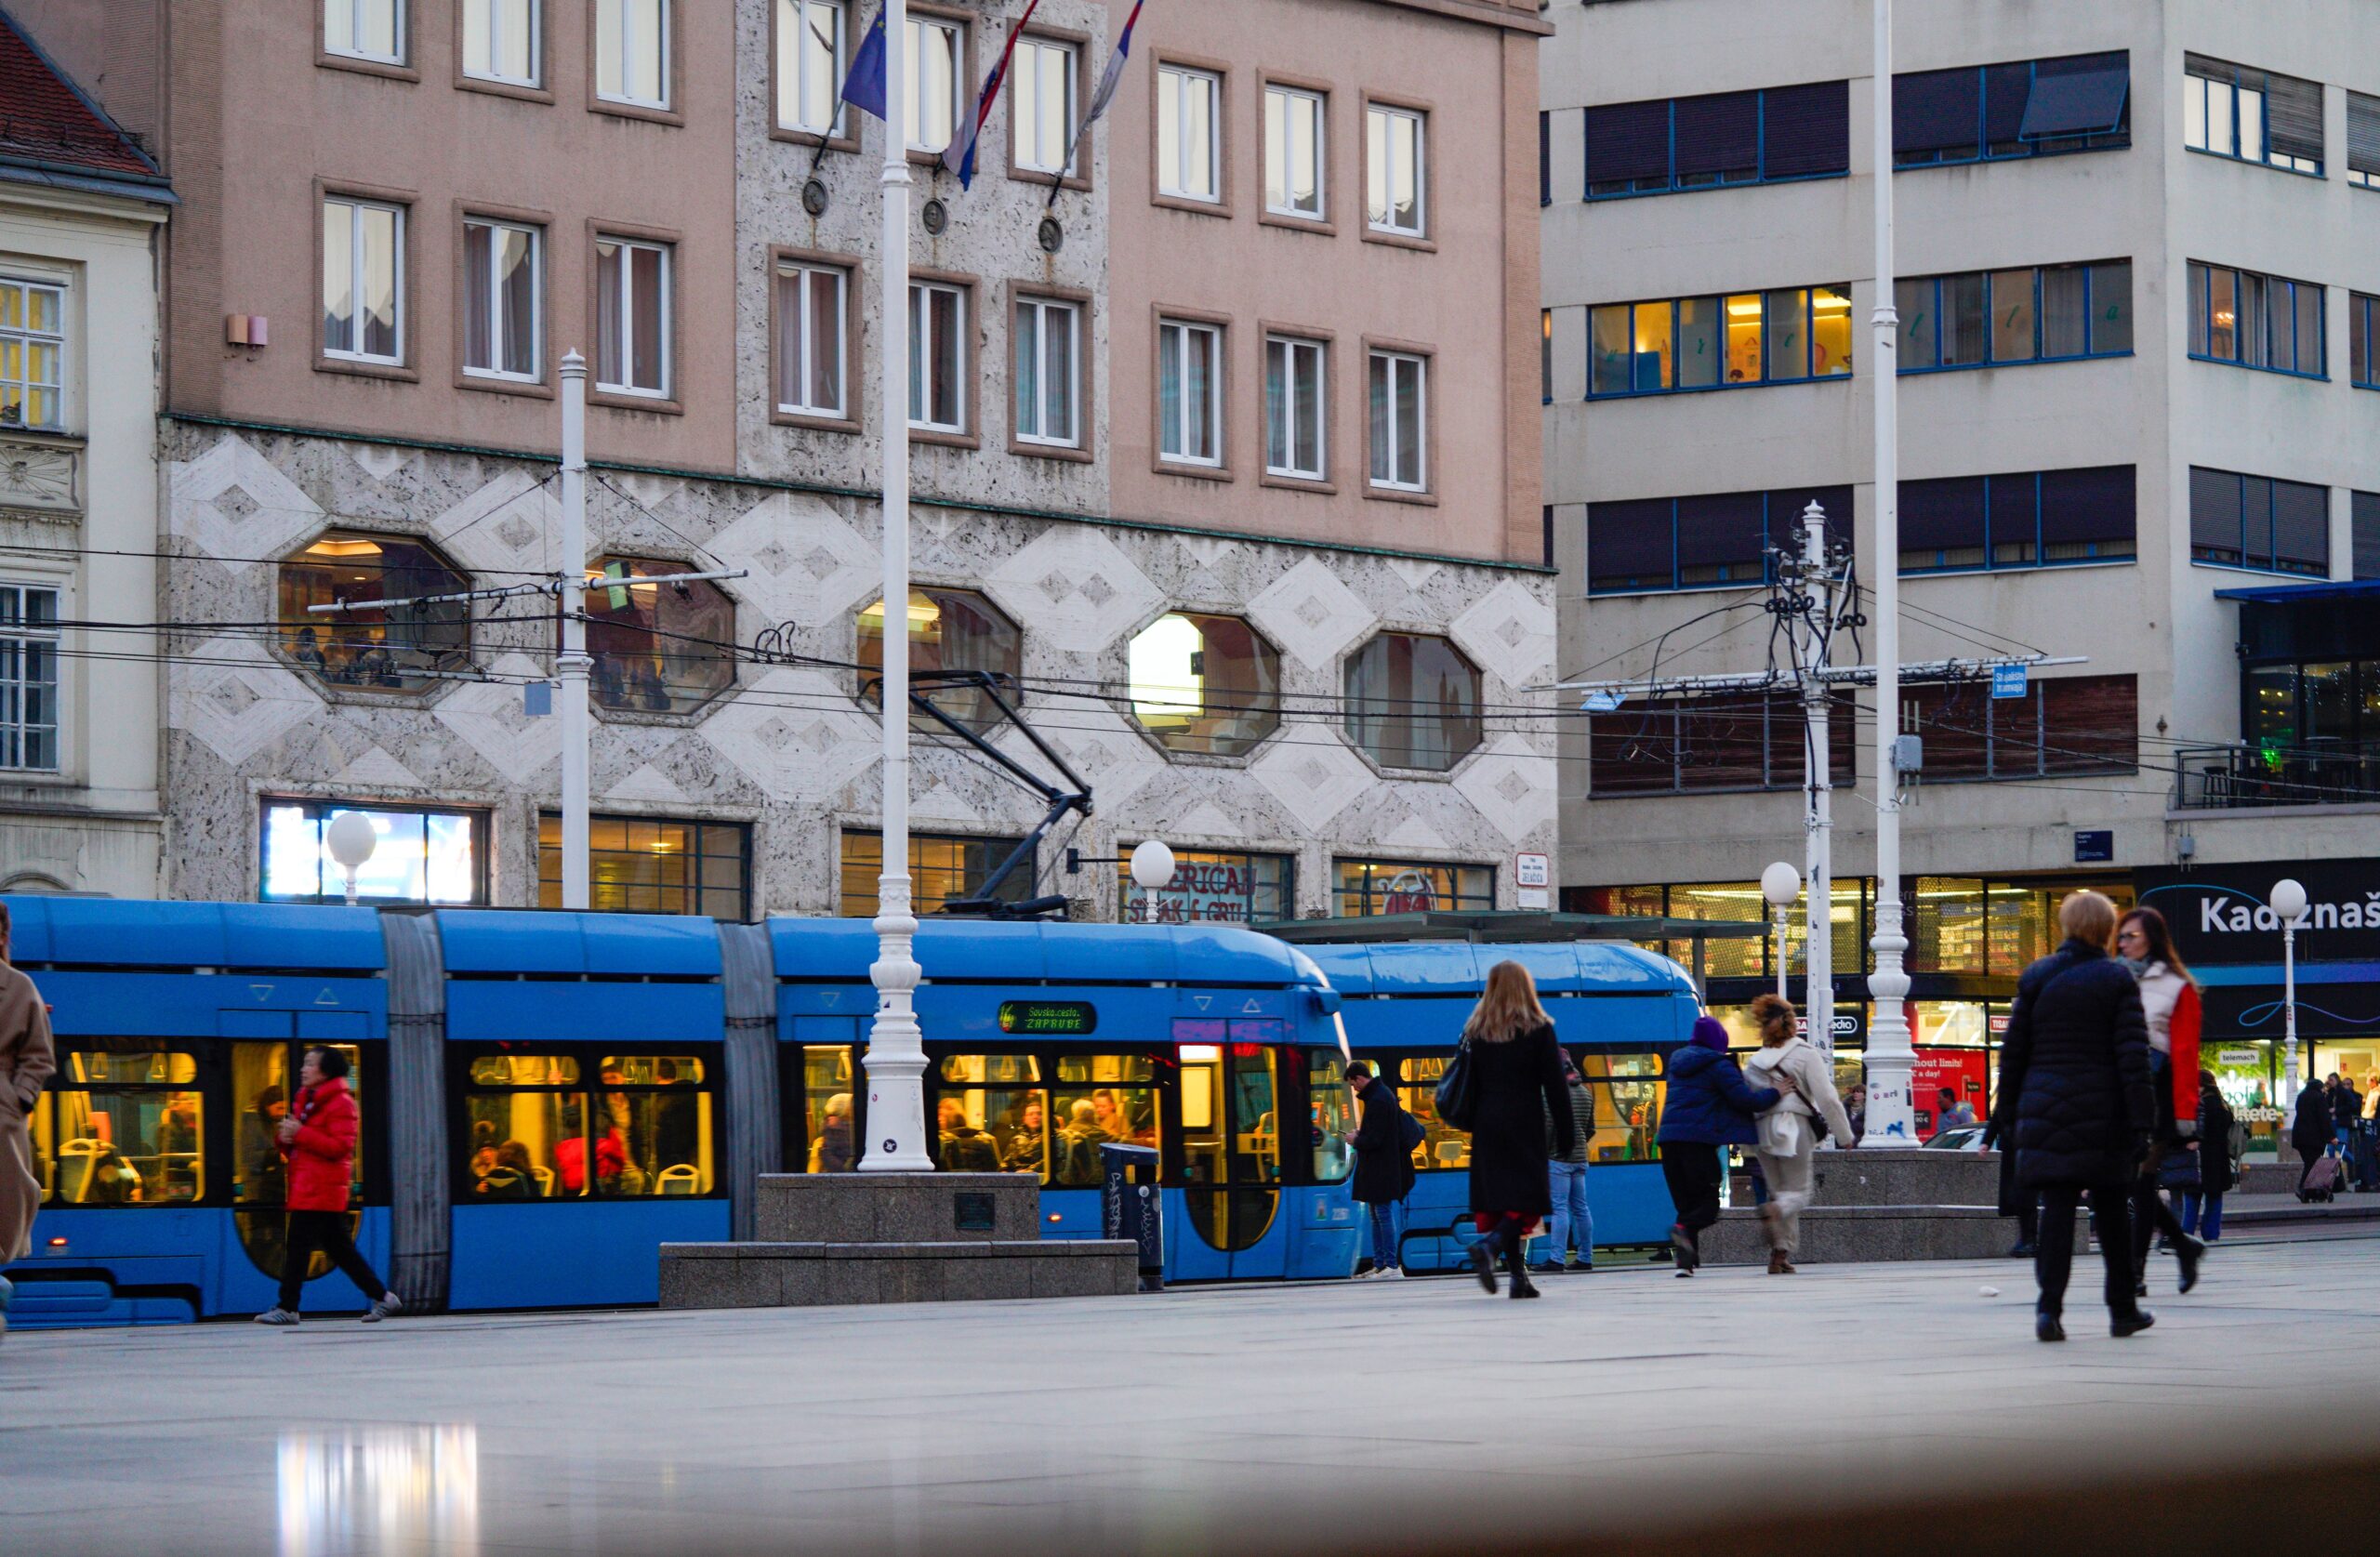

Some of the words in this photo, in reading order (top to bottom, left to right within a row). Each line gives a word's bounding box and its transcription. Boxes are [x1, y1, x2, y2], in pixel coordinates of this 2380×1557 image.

[1130, 864, 1257, 895] ERICAN
[1129, 899, 1183, 922] STAK
[2201, 897, 2279, 932] Kad
[2293, 891, 2380, 930] znaš
[1912, 1058, 1937, 1067] hout
[1938, 1058, 1963, 1067] limits!
[2223, 1053, 2255, 1062] telemach
